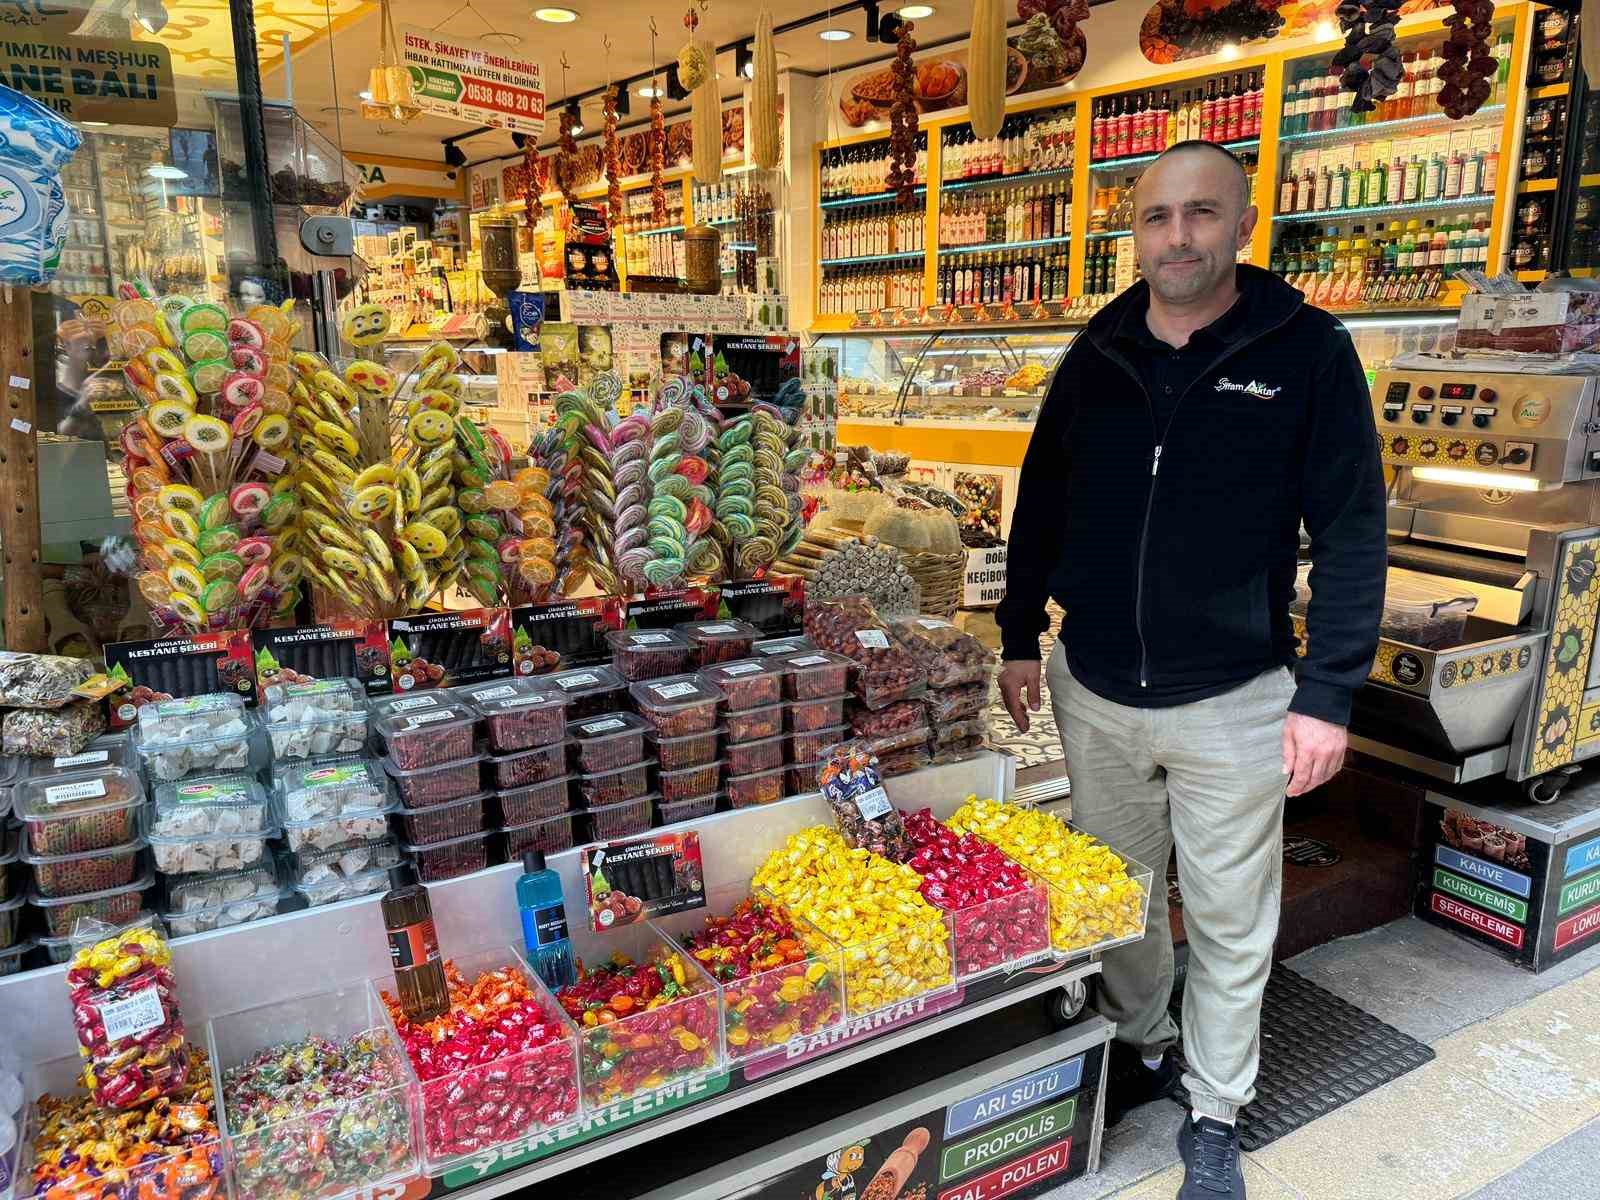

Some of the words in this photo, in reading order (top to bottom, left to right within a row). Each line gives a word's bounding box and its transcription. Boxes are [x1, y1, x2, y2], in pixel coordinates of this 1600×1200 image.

[77, 47, 161, 70] MEŞHUR
[405, 32, 434, 51] İSTEK,
[434, 40, 469, 59] ŞİKAYET
[471, 50, 482, 63] VE
[483, 51, 540, 76] ÖNERİLERİNİZİ
[71, 68, 158, 100] BALI
[404, 49, 429, 64] İHBAR
[431, 58, 472, 75] HATTIMIZA
[473, 67, 501, 81] LÜTFEN
[502, 74, 541, 90] BİLDİRİNİZ
[467, 83, 493, 103] 0538
[495, 90, 514, 108] 488
[516, 97, 529, 112] 20
[530, 98, 543, 114] 63
[726, 342, 756, 350] KESTANE
[985, 549, 1006, 565] DOĞ
[408, 622, 449, 633] KESTANE
[449, 618, 482, 630] ŞEKERİ
[529, 611, 566, 622] KESTANE
[566, 607, 595, 617] ŞEKERİ
[128, 645, 179, 659] KESTANE
[180, 641, 217, 654] ŞEKERİ
[274, 632, 318, 643] KESTANE
[320, 628, 355, 640] ŞEKERİ
[605, 850, 645, 864] KESTANE
[645, 843, 675, 857] ŞEKERİ
[1459, 856, 1504, 883] KAHVE
[1442, 875, 1516, 914] KURUYEMİŞ
[1439, 899, 1514, 940] ŞEKERLEME
[973, 1095, 1007, 1121] ARI
[1010, 1072, 1060, 1105] SÜTÜ
[963, 1114, 1056, 1167] PROPOLİS
[1001, 1150, 1061, 1189] POLEN
